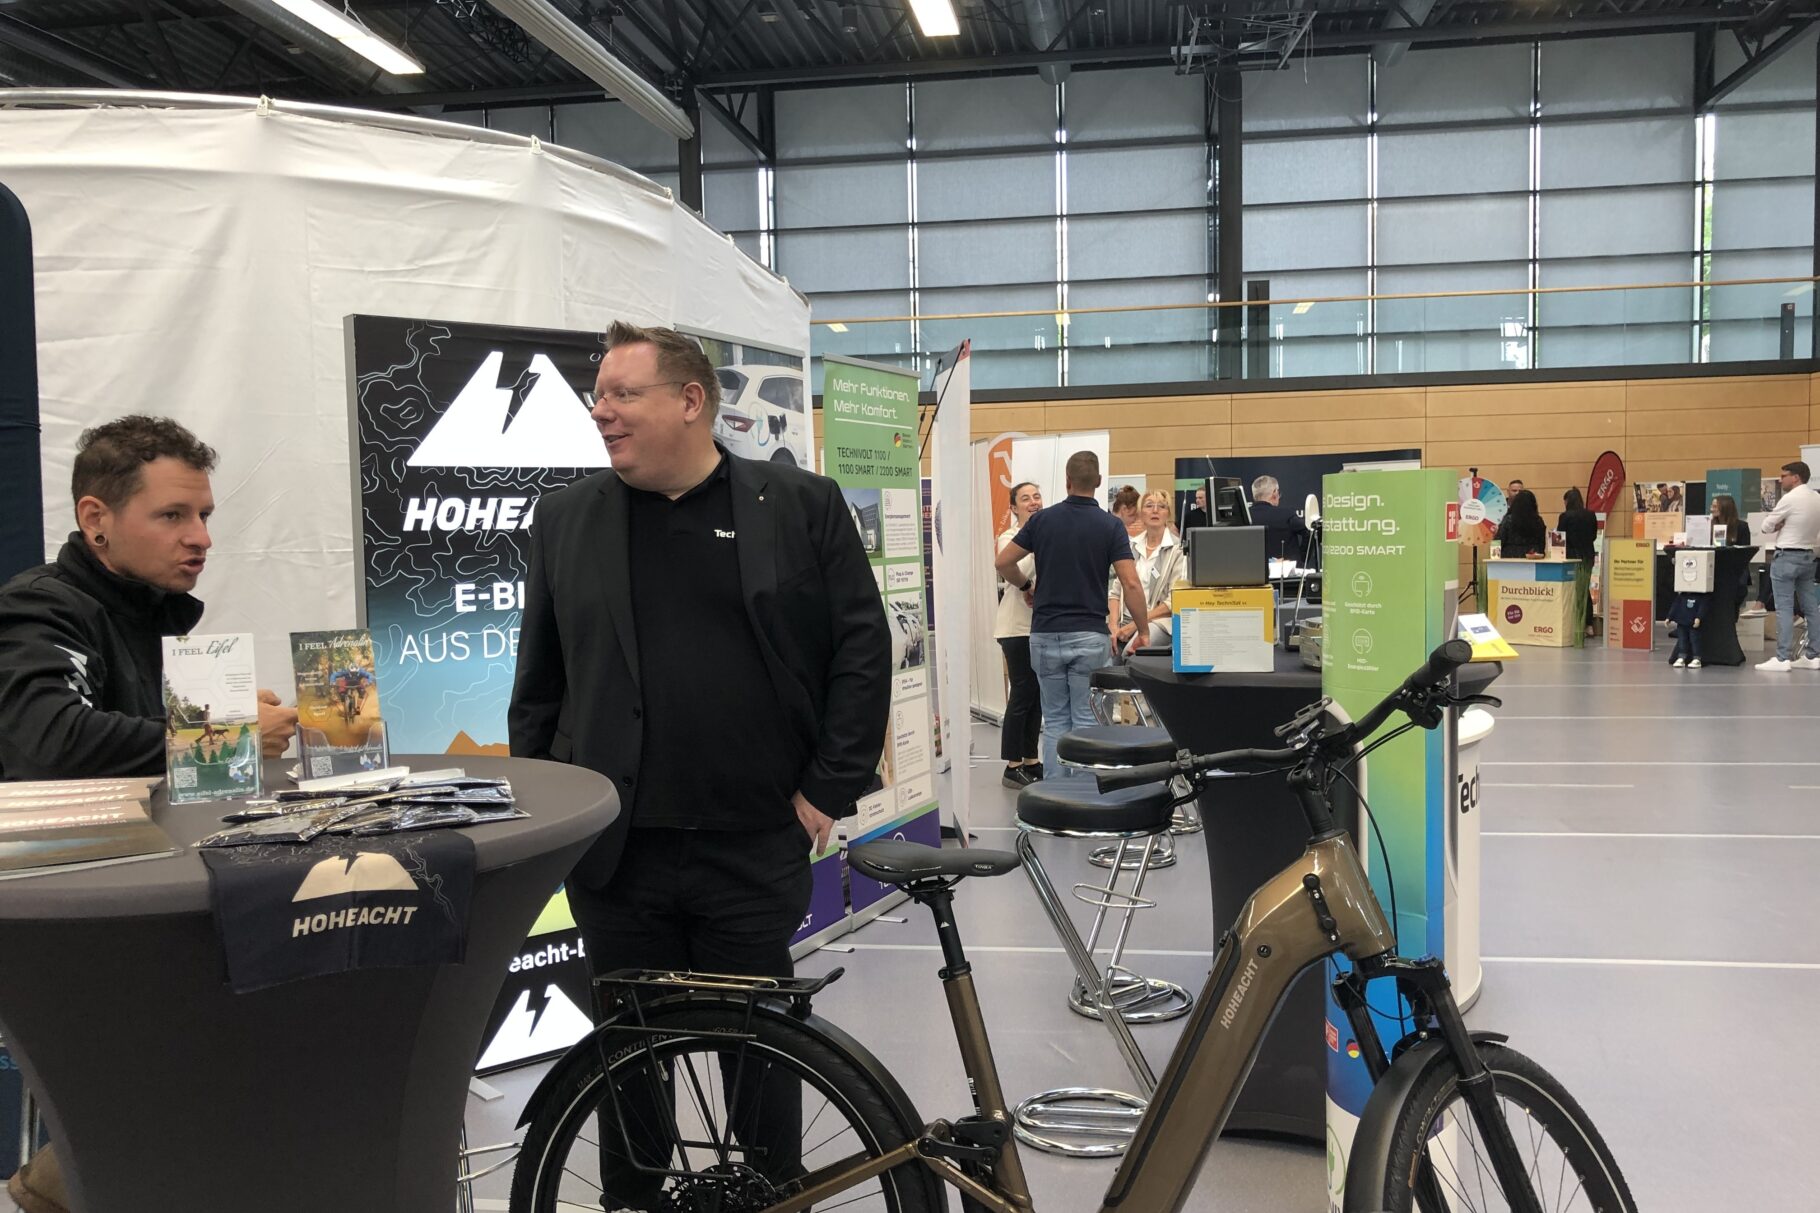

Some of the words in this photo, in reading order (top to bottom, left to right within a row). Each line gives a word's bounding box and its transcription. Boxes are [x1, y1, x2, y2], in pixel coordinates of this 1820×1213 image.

[833, 379, 859, 393] Mehr
[860, 383, 910, 402] Funktionen.
[833, 399, 860, 414] Mehr
[861, 403, 899, 419] Komfort.
[837, 447, 873, 459] TECHNIVOLT
[874, 450, 886, 460] 1100
[838, 463, 854, 475] 1100
[855, 464, 874, 475] SMART
[880, 466, 894, 476] 2200
[894, 467, 912, 477] SMART
[1596, 468, 1614, 500] ERGO
[1327, 492, 1384, 511] Design.
[1356, 545, 1405, 555] SMART
[1501, 585, 1554, 596] Durchblick!
[1534, 626, 1553, 634] ERGO
[178, 648, 203, 656] FEEL
[206, 636, 239, 658] Eifel
[304, 642, 327, 650] FEEL
[399, 631, 471, 665] AUS
[292, 906, 418, 938] HOHEACHT
[1220, 957, 1259, 1029] HOHEACHT
